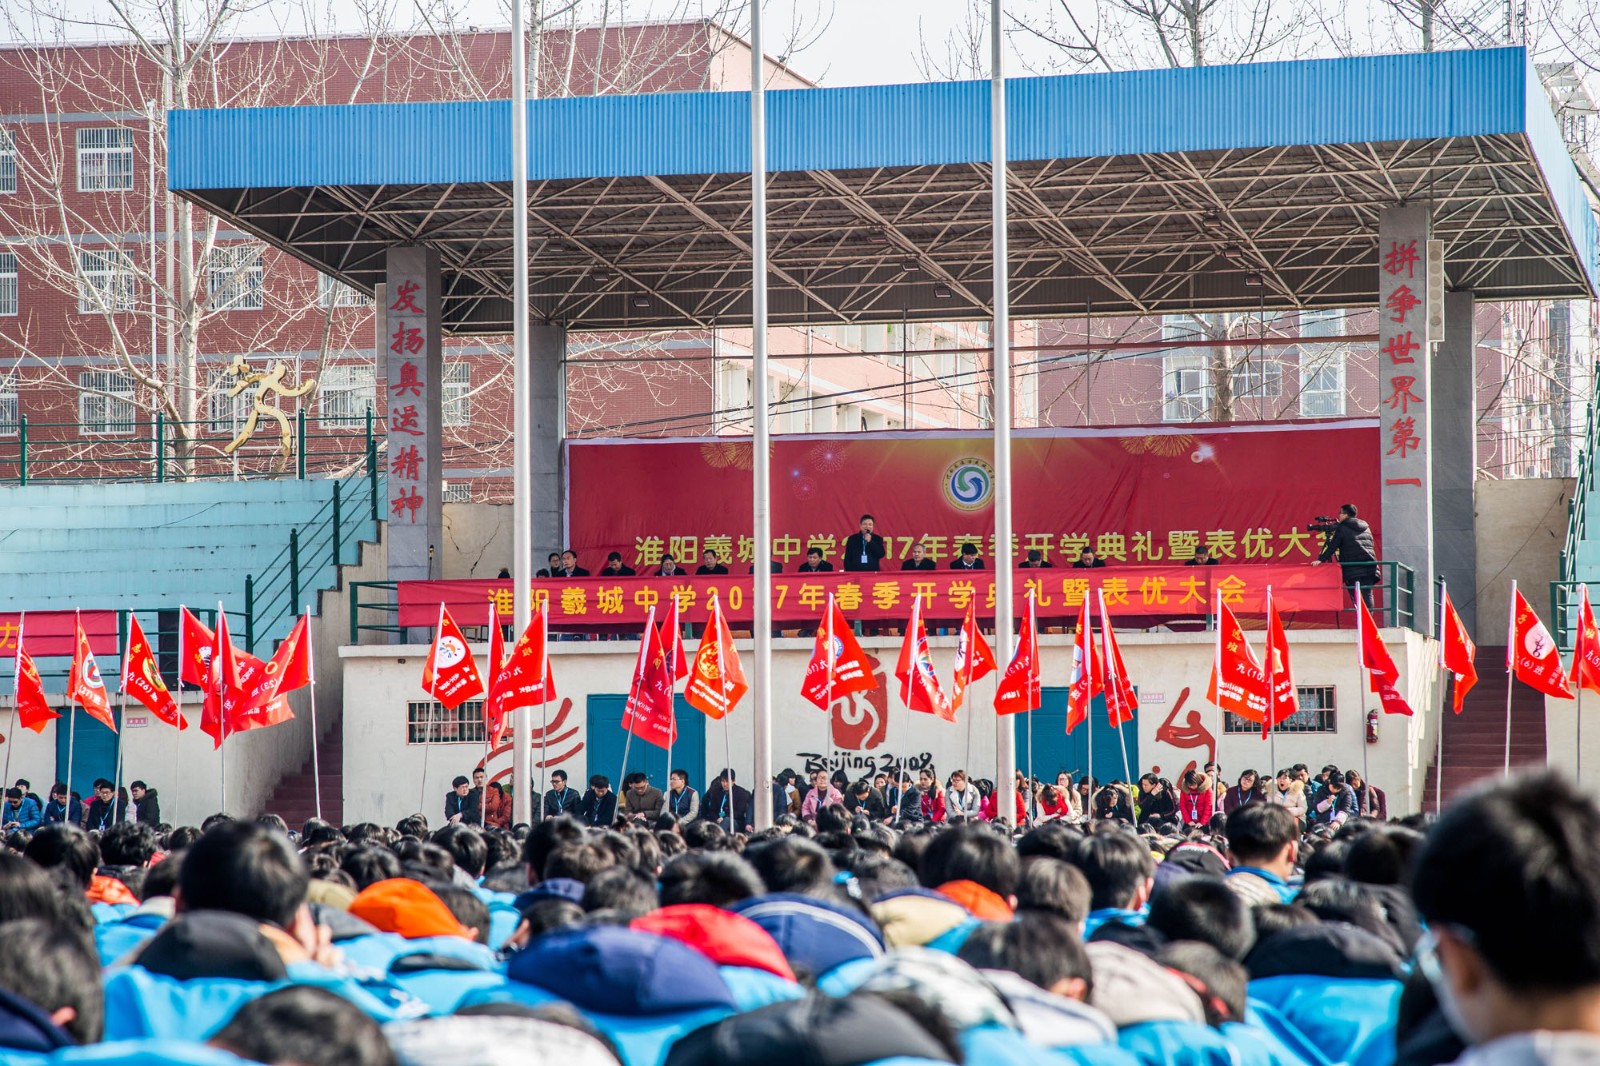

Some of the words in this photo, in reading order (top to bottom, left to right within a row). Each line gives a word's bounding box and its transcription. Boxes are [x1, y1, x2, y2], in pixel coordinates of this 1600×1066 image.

[389, 279, 425, 524] 发扬奥运精神
[1382, 239, 1424, 488] 拼争世界第一
